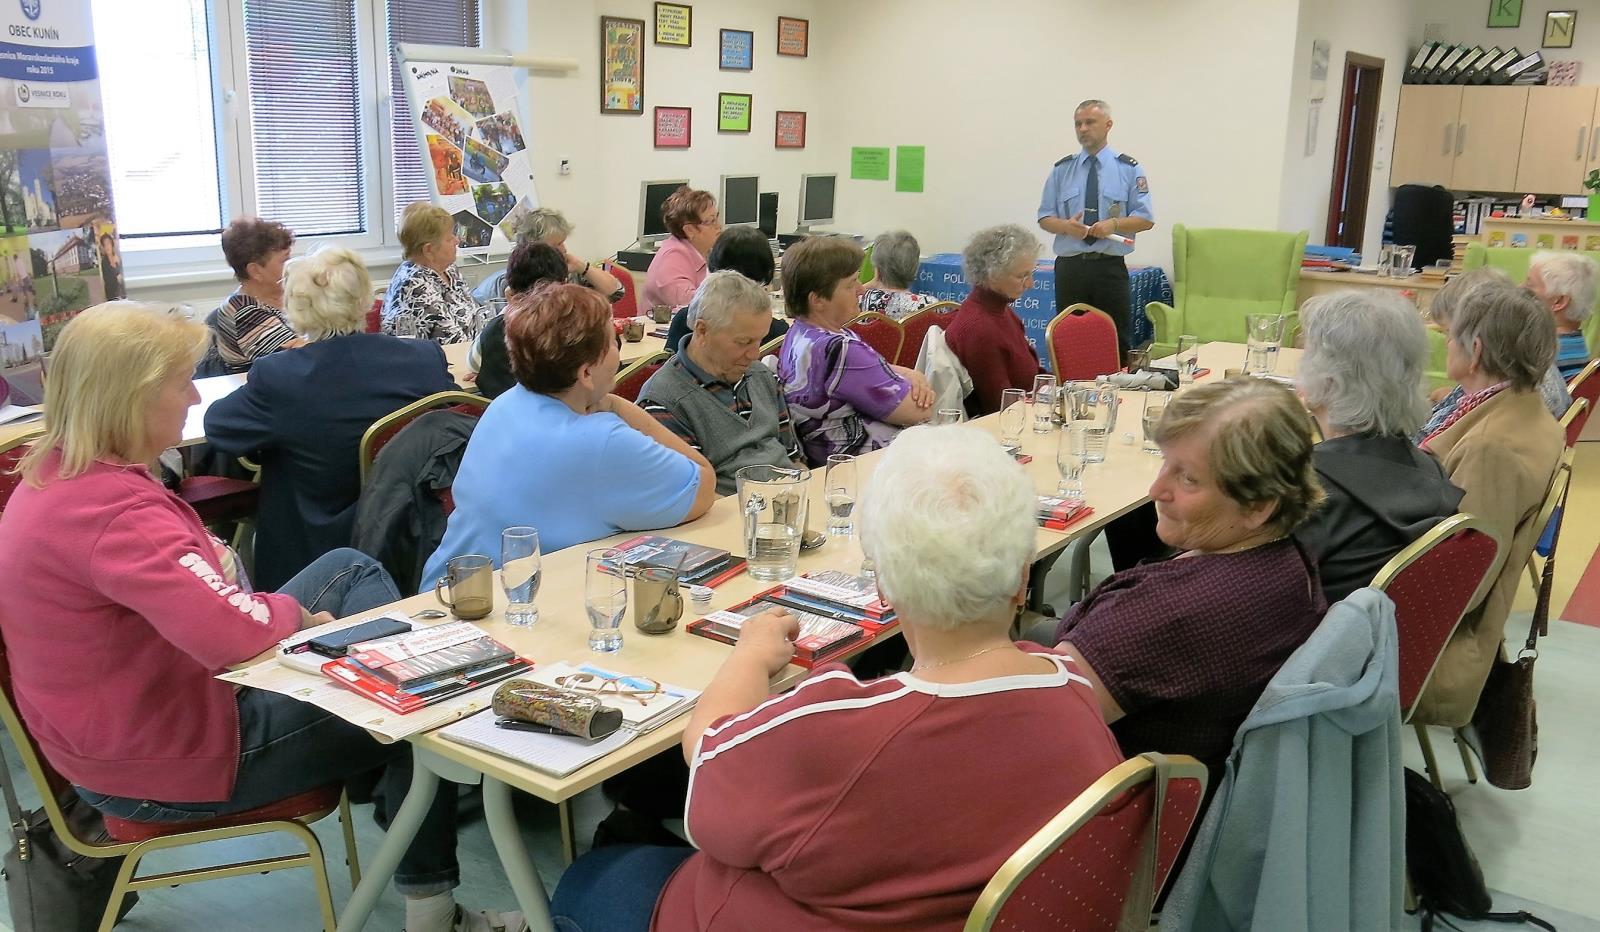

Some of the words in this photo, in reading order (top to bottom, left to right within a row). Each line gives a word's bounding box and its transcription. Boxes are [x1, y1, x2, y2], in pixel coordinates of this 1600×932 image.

[1495, 0, 1513, 16] K
[9, 25, 32, 37] OBEC
[33, 27, 59, 40] KUNÍN
[1549, 17, 1572, 37] N
[40, 65, 54, 74] 2015
[920, 270, 934, 282] ČR
[943, 273, 966, 284] POLI
[1024, 296, 1040, 309] ČR
[1023, 318, 1048, 330] LICIE
